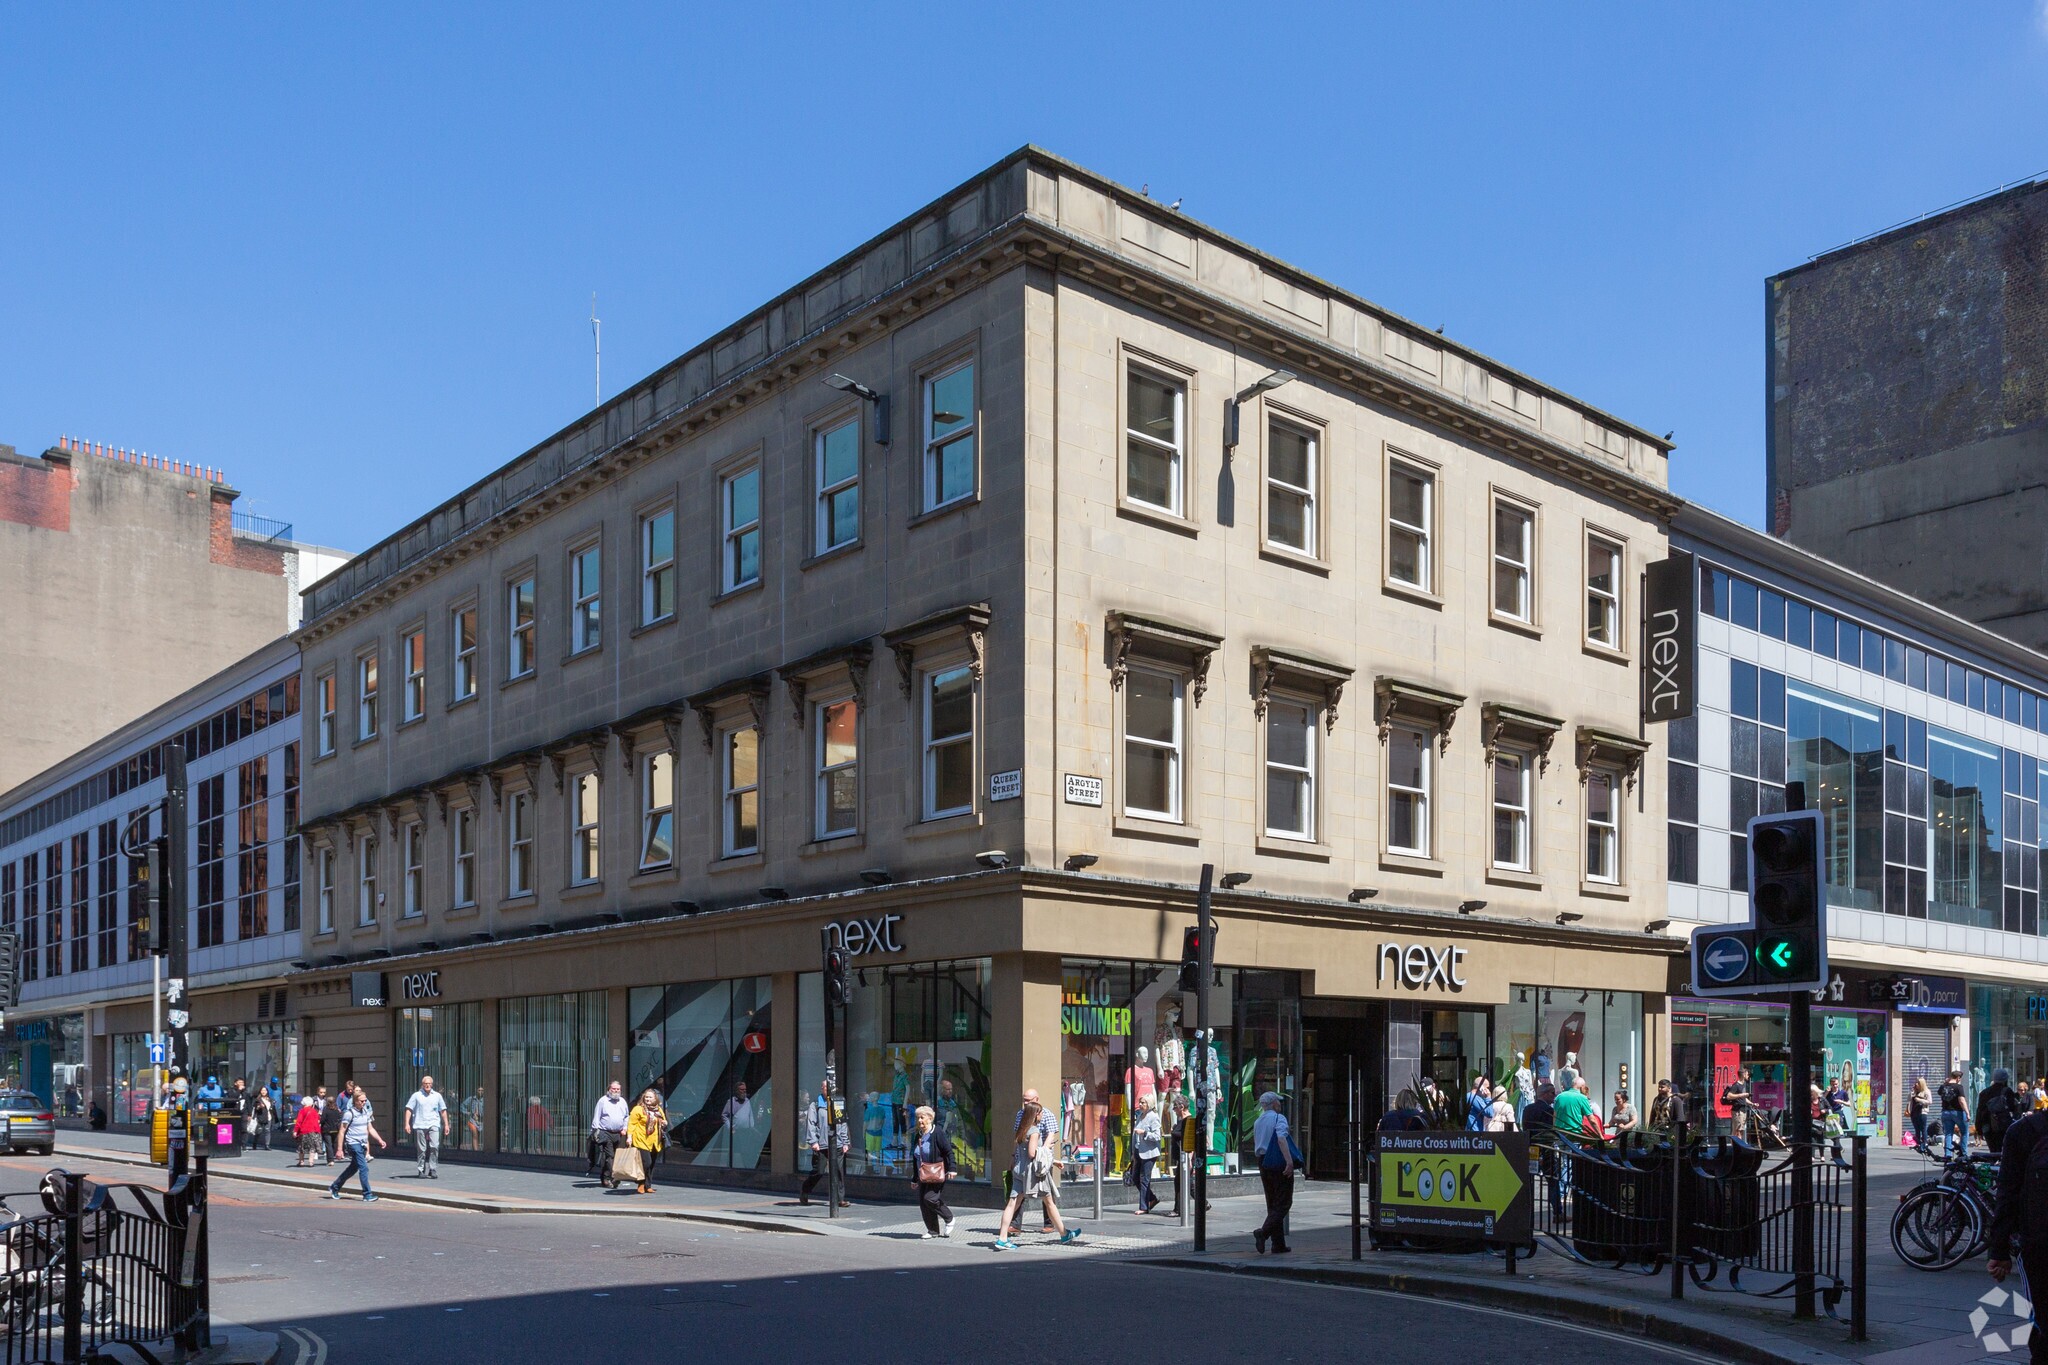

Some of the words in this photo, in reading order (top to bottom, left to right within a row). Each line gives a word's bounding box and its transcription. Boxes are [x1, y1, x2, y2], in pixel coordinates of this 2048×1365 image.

[1652, 609, 1680, 714] next
[993, 773, 1018, 784] QUEEN
[1068, 777, 1100, 789] ARGYLE
[992, 783, 1020, 795] STREET
[1068, 786, 1100, 799] STREET
[827, 914, 902, 955] next
[1381, 942, 1468, 986] next
[402, 971, 439, 999] next
[1061, 976, 1110, 1006] HELLO
[1932, 990, 1958, 1004] sports
[1061, 1006, 1131, 1036] SUMMER
[16, 1022, 47, 1040] PRIMARK
[1381, 1136, 1393, 1148] Be
[1394, 1137, 1422, 1149] Aware
[1423, 1137, 1448, 1149] Cross
[1449, 1137, 1471, 1149] with
[1472, 1137, 1493, 1150] Care
[1397, 1161, 1481, 1202] LOOK
[1441, 1219, 1460, 1227] Glasgow's
